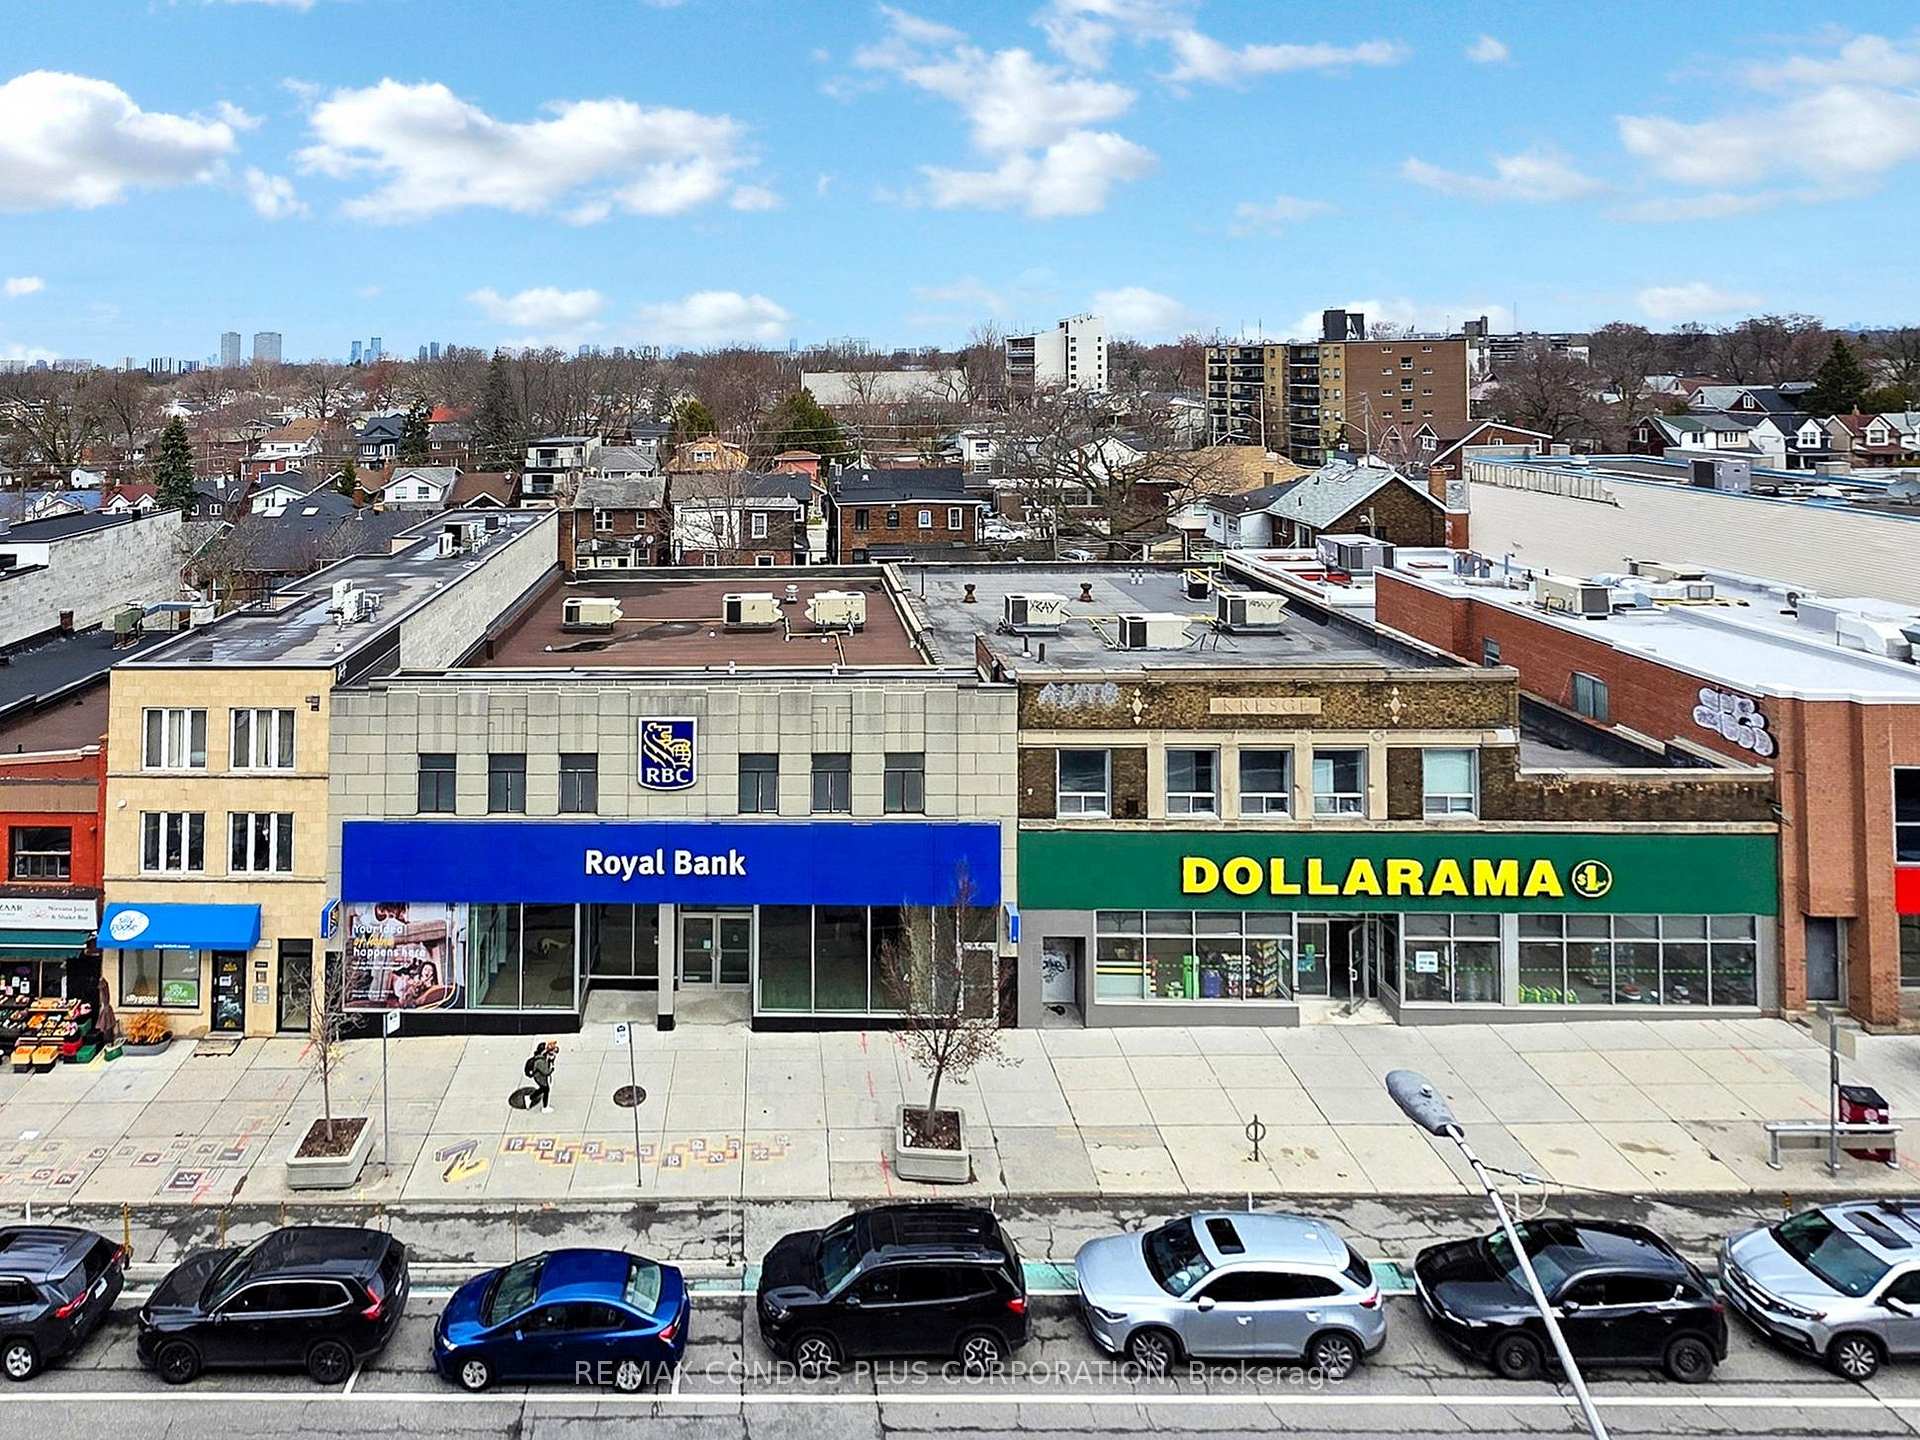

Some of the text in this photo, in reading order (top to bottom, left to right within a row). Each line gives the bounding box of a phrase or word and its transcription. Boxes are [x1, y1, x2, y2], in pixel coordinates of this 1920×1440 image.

[1223, 698, 1314, 713] KRESGE
[646, 767, 689, 783] RBC
[585, 848, 747, 881] Royal Bank
[1182, 856, 1564, 896] DOLLARAMA
[354, 924, 378, 934] Your
[353, 946, 426, 959] happens here
